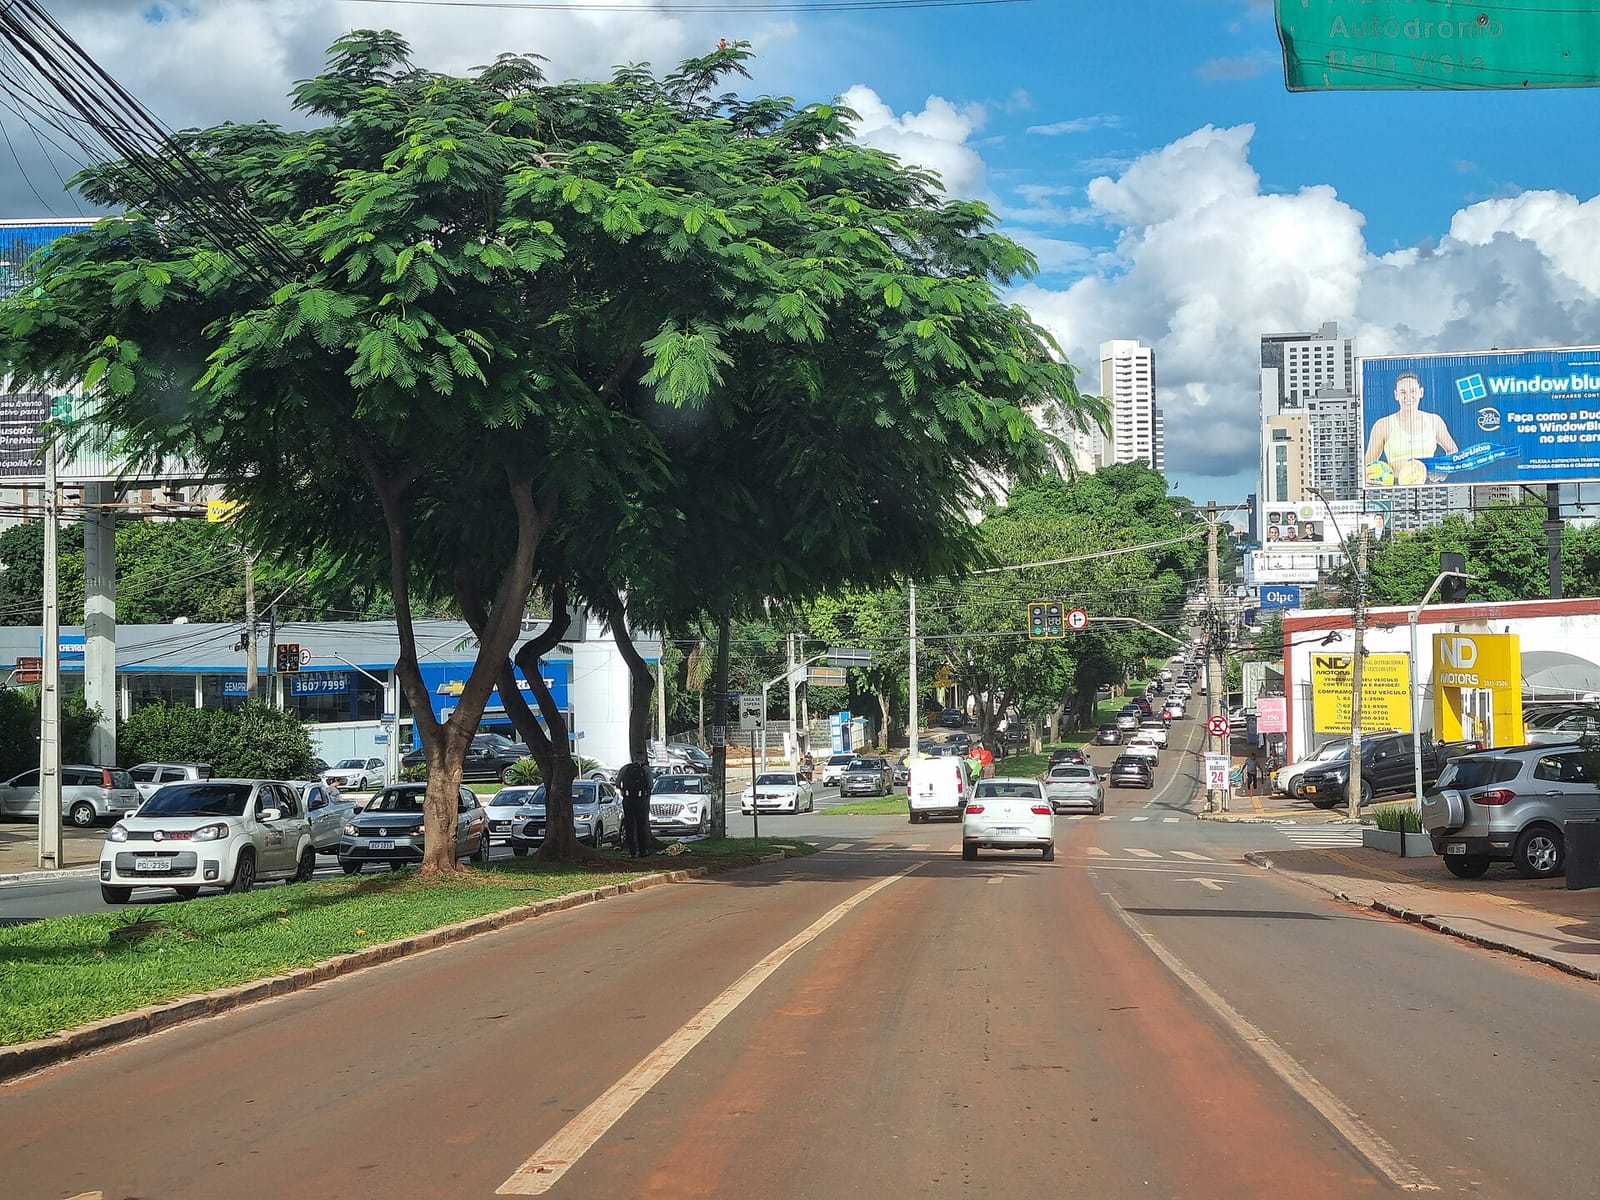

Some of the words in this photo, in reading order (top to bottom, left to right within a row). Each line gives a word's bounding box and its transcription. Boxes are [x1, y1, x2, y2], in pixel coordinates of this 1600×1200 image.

[1489, 375, 1569, 394] Window
[1507, 413, 1534, 424] Faça
[1536, 413, 1567, 422] como
[1569, 412, 1577, 421] a
[1517, 425, 1537, 433] use
[1540, 435, 1555, 444] no
[1557, 434, 1578, 442] seu
[1441, 637, 1478, 669] ND
[1441, 673, 1479, 685] MOTORS
[296, 681, 319, 692] 3607
[322, 680, 345, 690] 7999
[1211, 771, 1224, 783] 24
